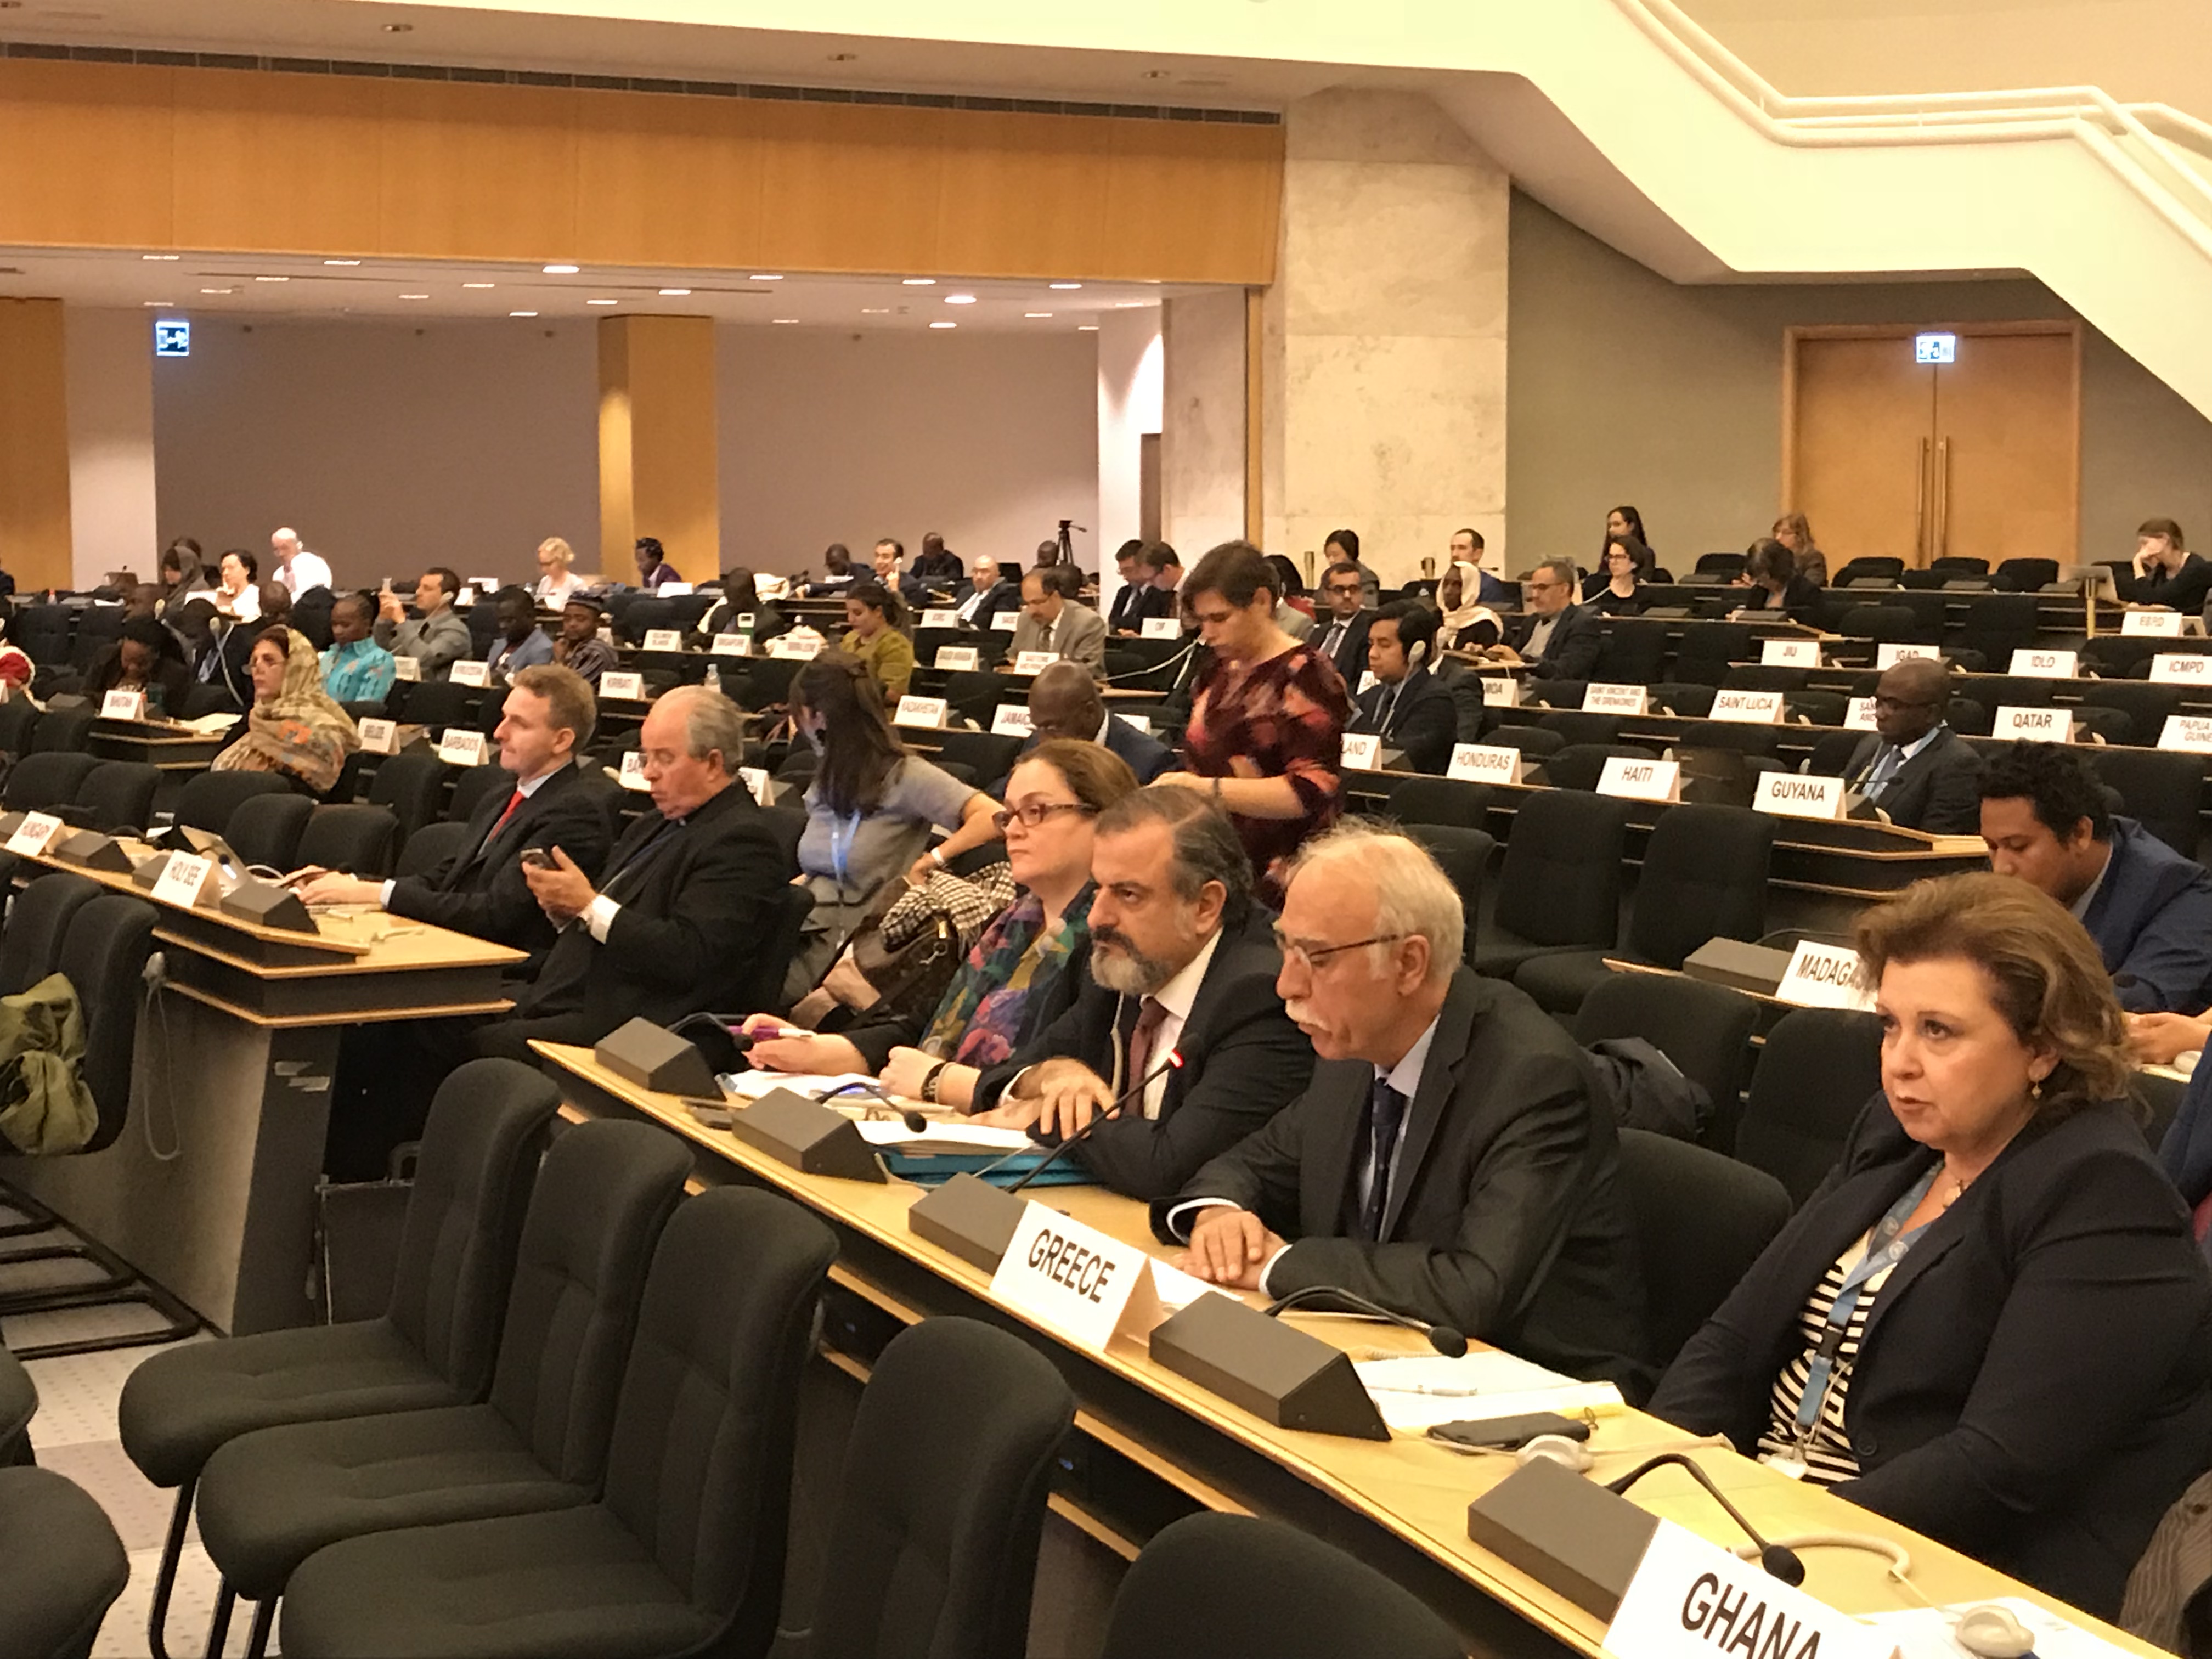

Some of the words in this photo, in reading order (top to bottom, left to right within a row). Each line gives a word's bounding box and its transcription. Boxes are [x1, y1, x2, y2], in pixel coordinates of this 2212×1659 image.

[1784, 646, 1797, 657] JIU
[2031, 656, 2055, 668] IDLO
[2169, 661, 2204, 673] ICMPD
[1718, 697, 1746, 708] SAINT
[1746, 698, 1773, 709] LUCIA
[2013, 714, 2052, 729] QATAR
[2179, 720, 2209, 730] PAPUA
[1457, 751, 1510, 770] HONDURAS
[1621, 766, 1654, 782] HAITI
[1772, 780, 1825, 802] GUYANA
[1028, 1228, 1116, 1304] GREECE
[1681, 1572, 1821, 1659] GHANA
